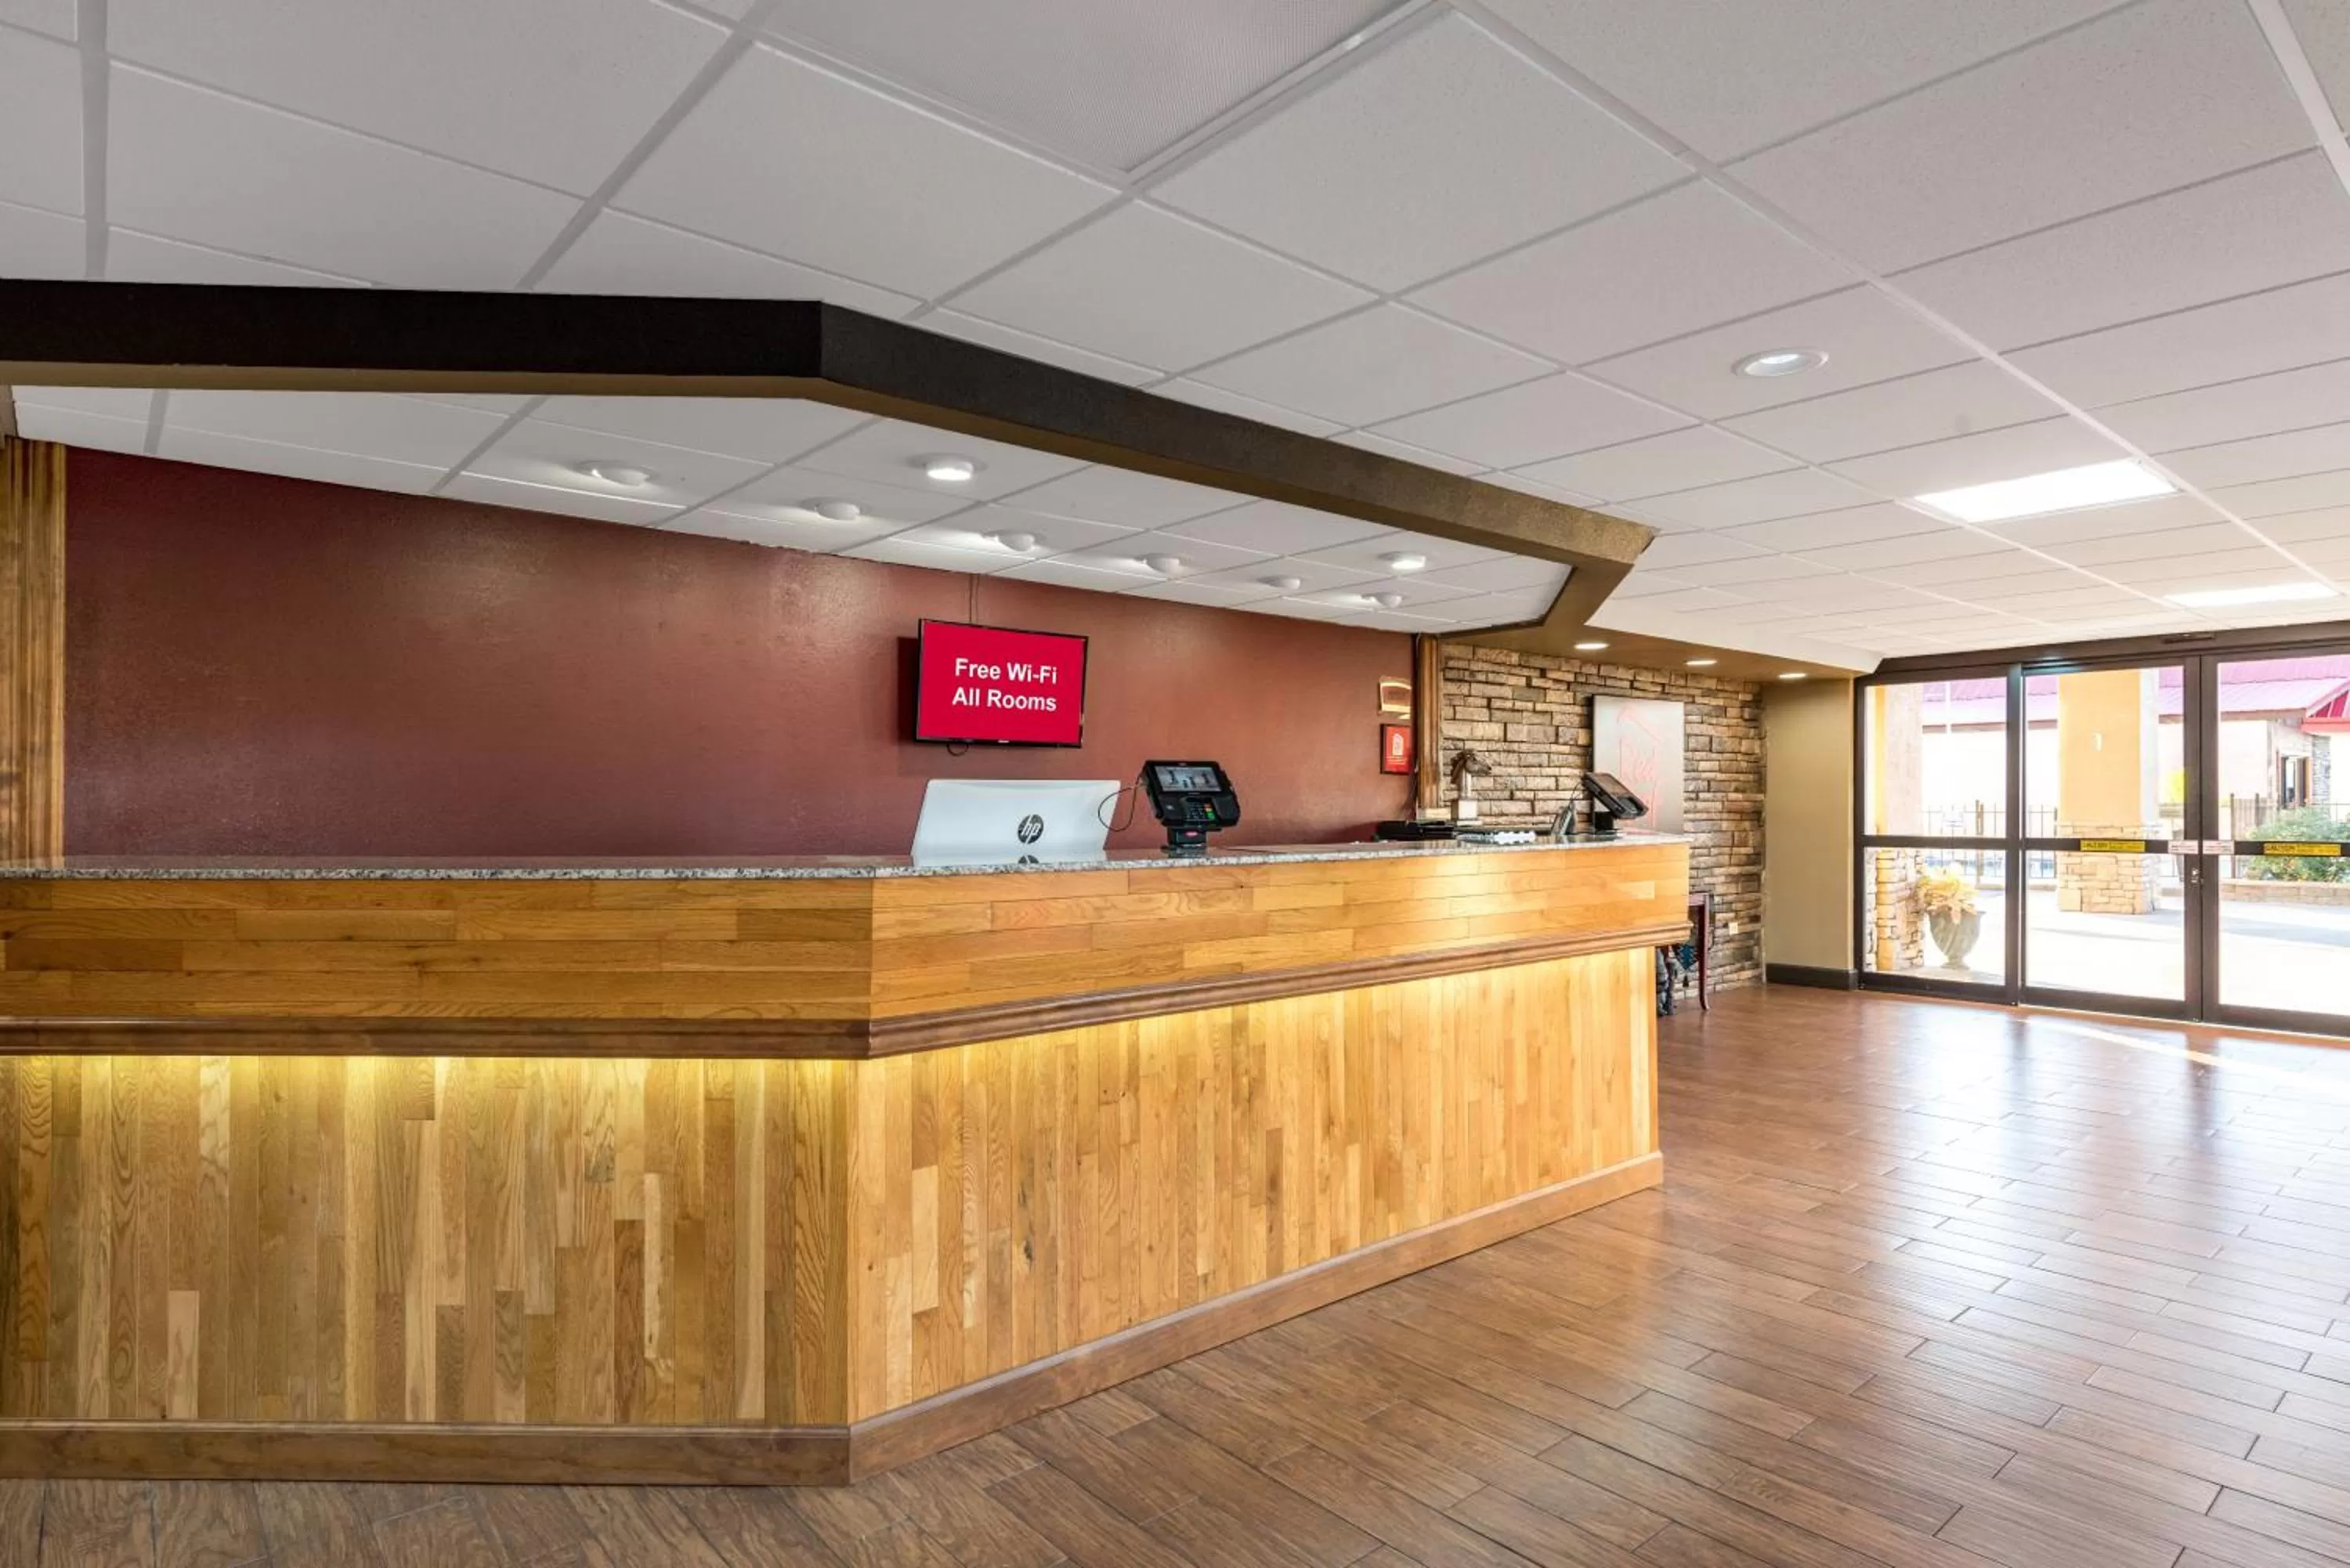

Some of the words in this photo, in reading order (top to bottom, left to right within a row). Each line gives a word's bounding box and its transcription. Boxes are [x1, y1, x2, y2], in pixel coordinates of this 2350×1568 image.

[955, 657, 1001, 680] Free
[1007, 662, 1058, 685] Wi-Fi
[952, 687, 981, 706] All
[987, 688, 1058, 712] Rooms
[1020, 815, 1042, 844] hp
